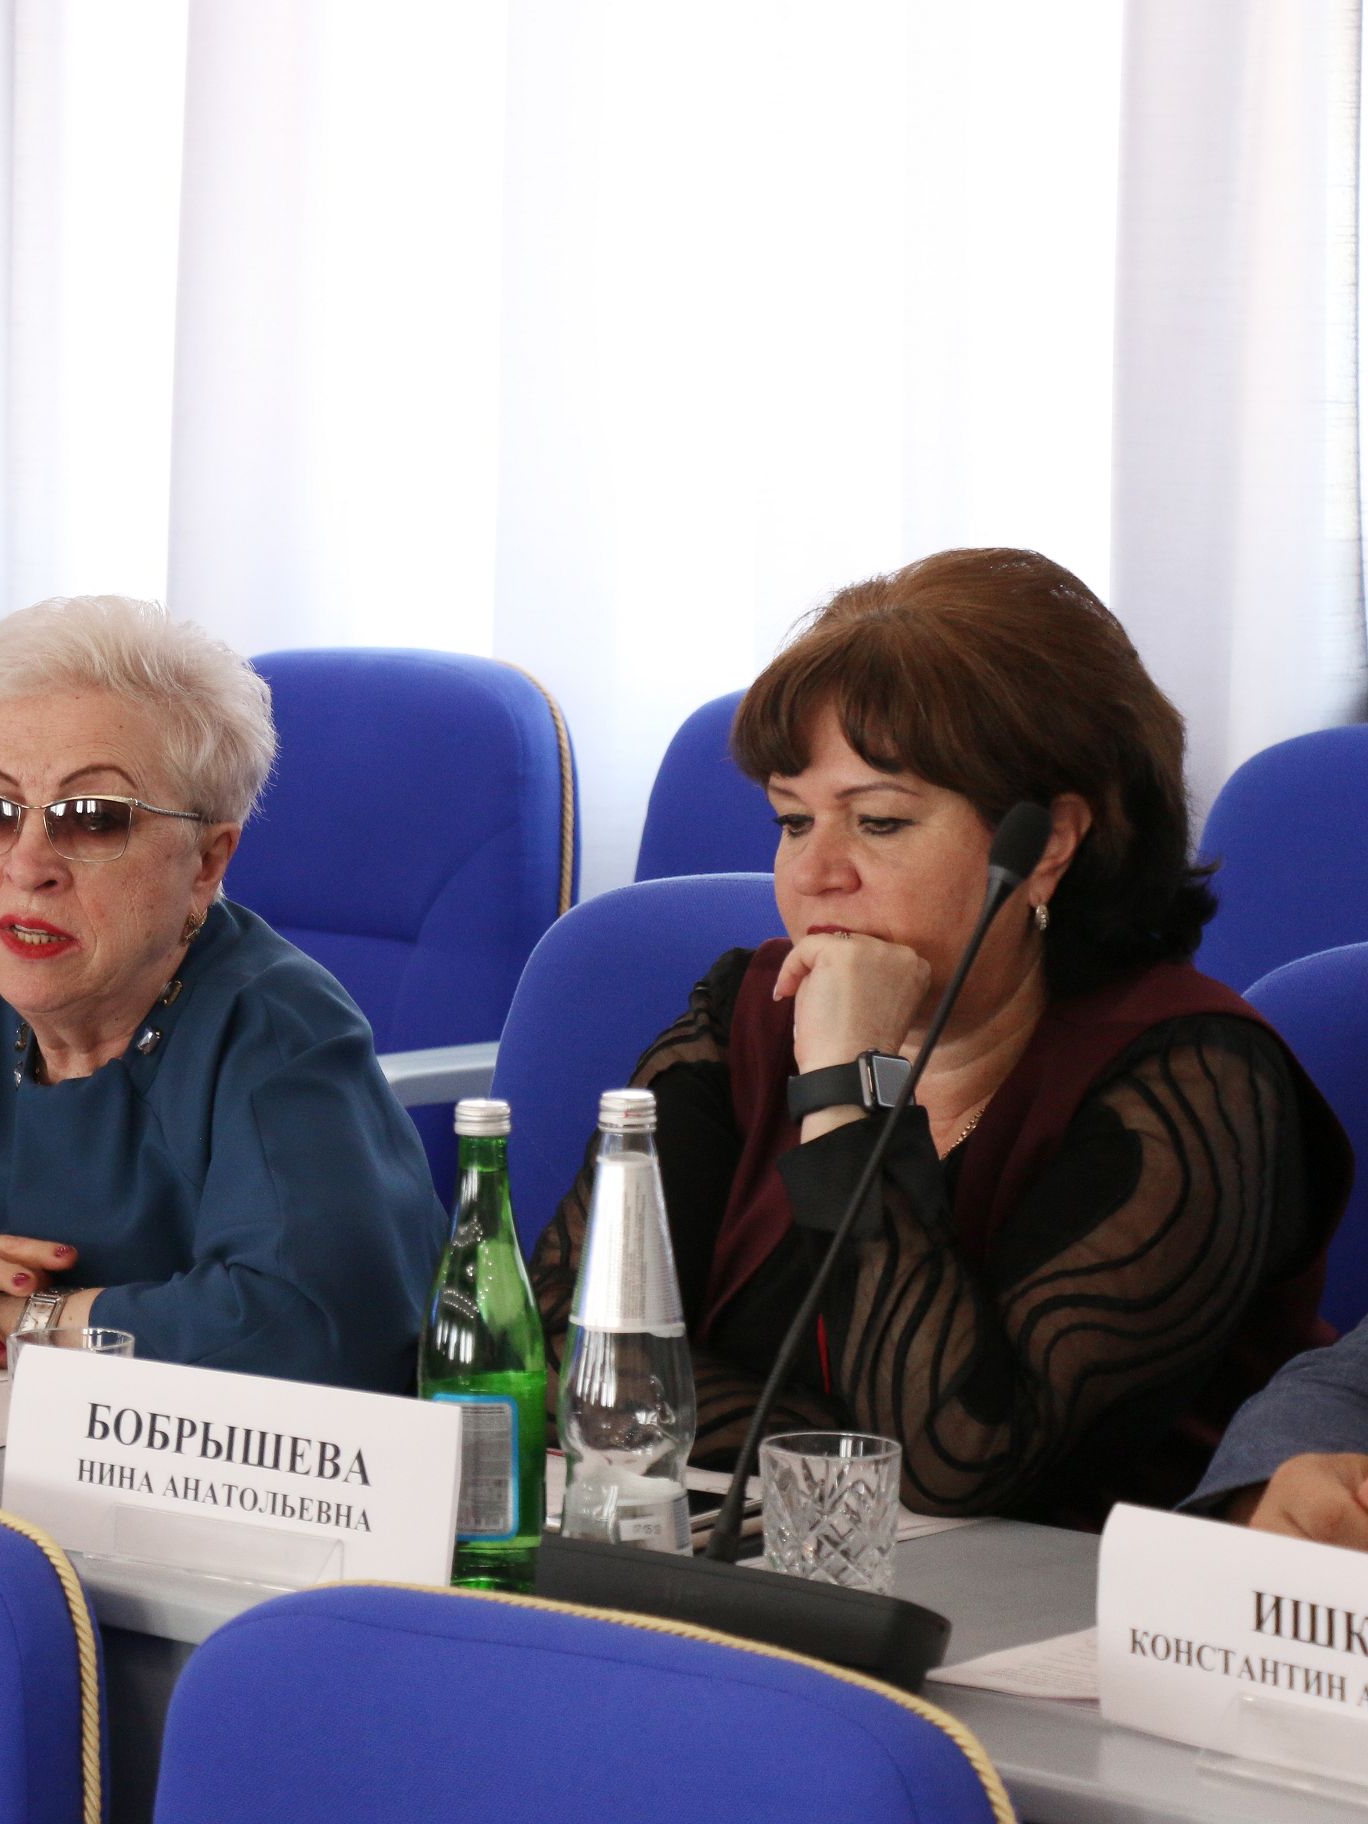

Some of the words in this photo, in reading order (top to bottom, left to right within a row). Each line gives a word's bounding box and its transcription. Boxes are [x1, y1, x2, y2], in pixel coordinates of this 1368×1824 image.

[84, 1402, 372, 1486] БОБРЫШЕВА
[77, 1458, 154, 1494] НИНА
[163, 1474, 372, 1532] АНАТОЛЬЕВНА
[1130, 1627, 1347, 1702] КОНСТАНТИН
